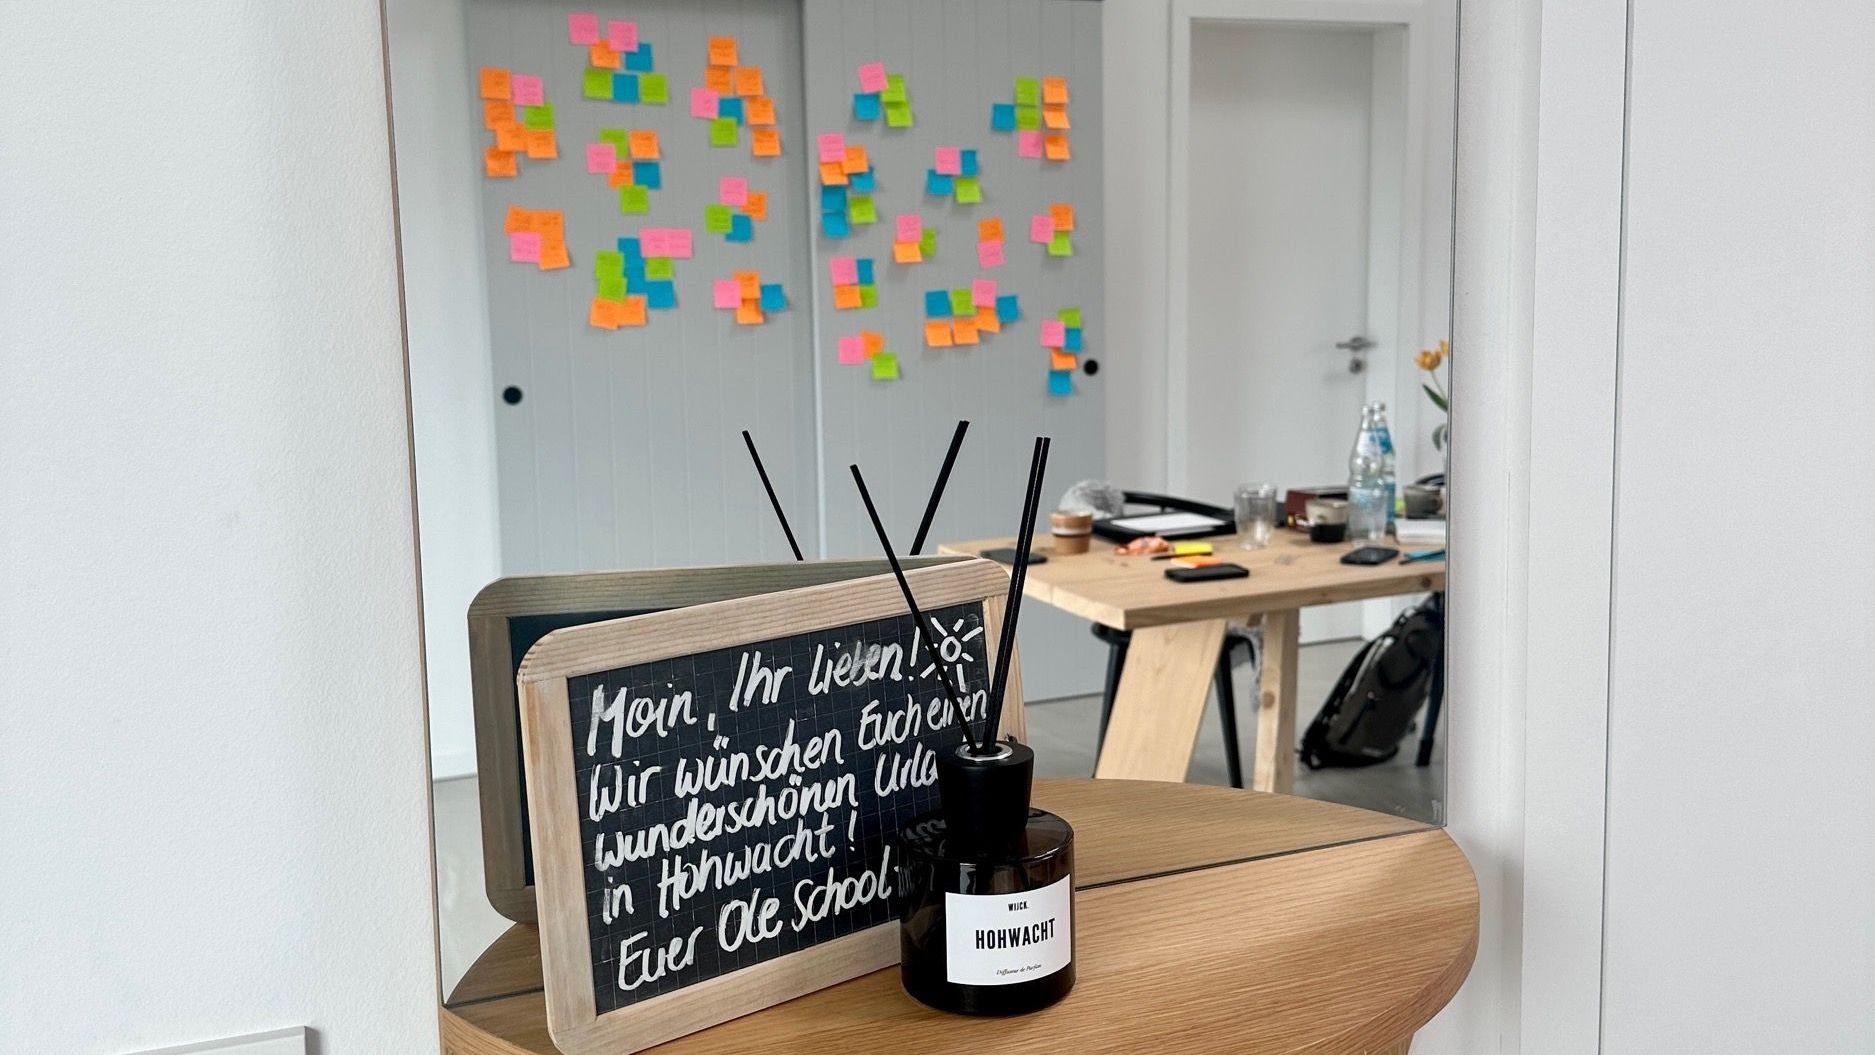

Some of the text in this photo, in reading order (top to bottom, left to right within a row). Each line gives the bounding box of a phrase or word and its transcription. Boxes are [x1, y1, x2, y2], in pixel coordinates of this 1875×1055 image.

[587, 683, 717, 759] Moin,
[728, 651, 793, 712] Ihr
[589, 760, 663, 822] Wir
[674, 718, 845, 799] wünschen
[857, 693, 922, 751] Euch
[594, 773, 859, 872] wunderschönen
[874, 741, 940, 798] Urla
[602, 876, 635, 925] in
[618, 926, 704, 992] Euer
[718, 887, 784, 953] Ole
[975, 917, 1056, 950] HOHWACHT
